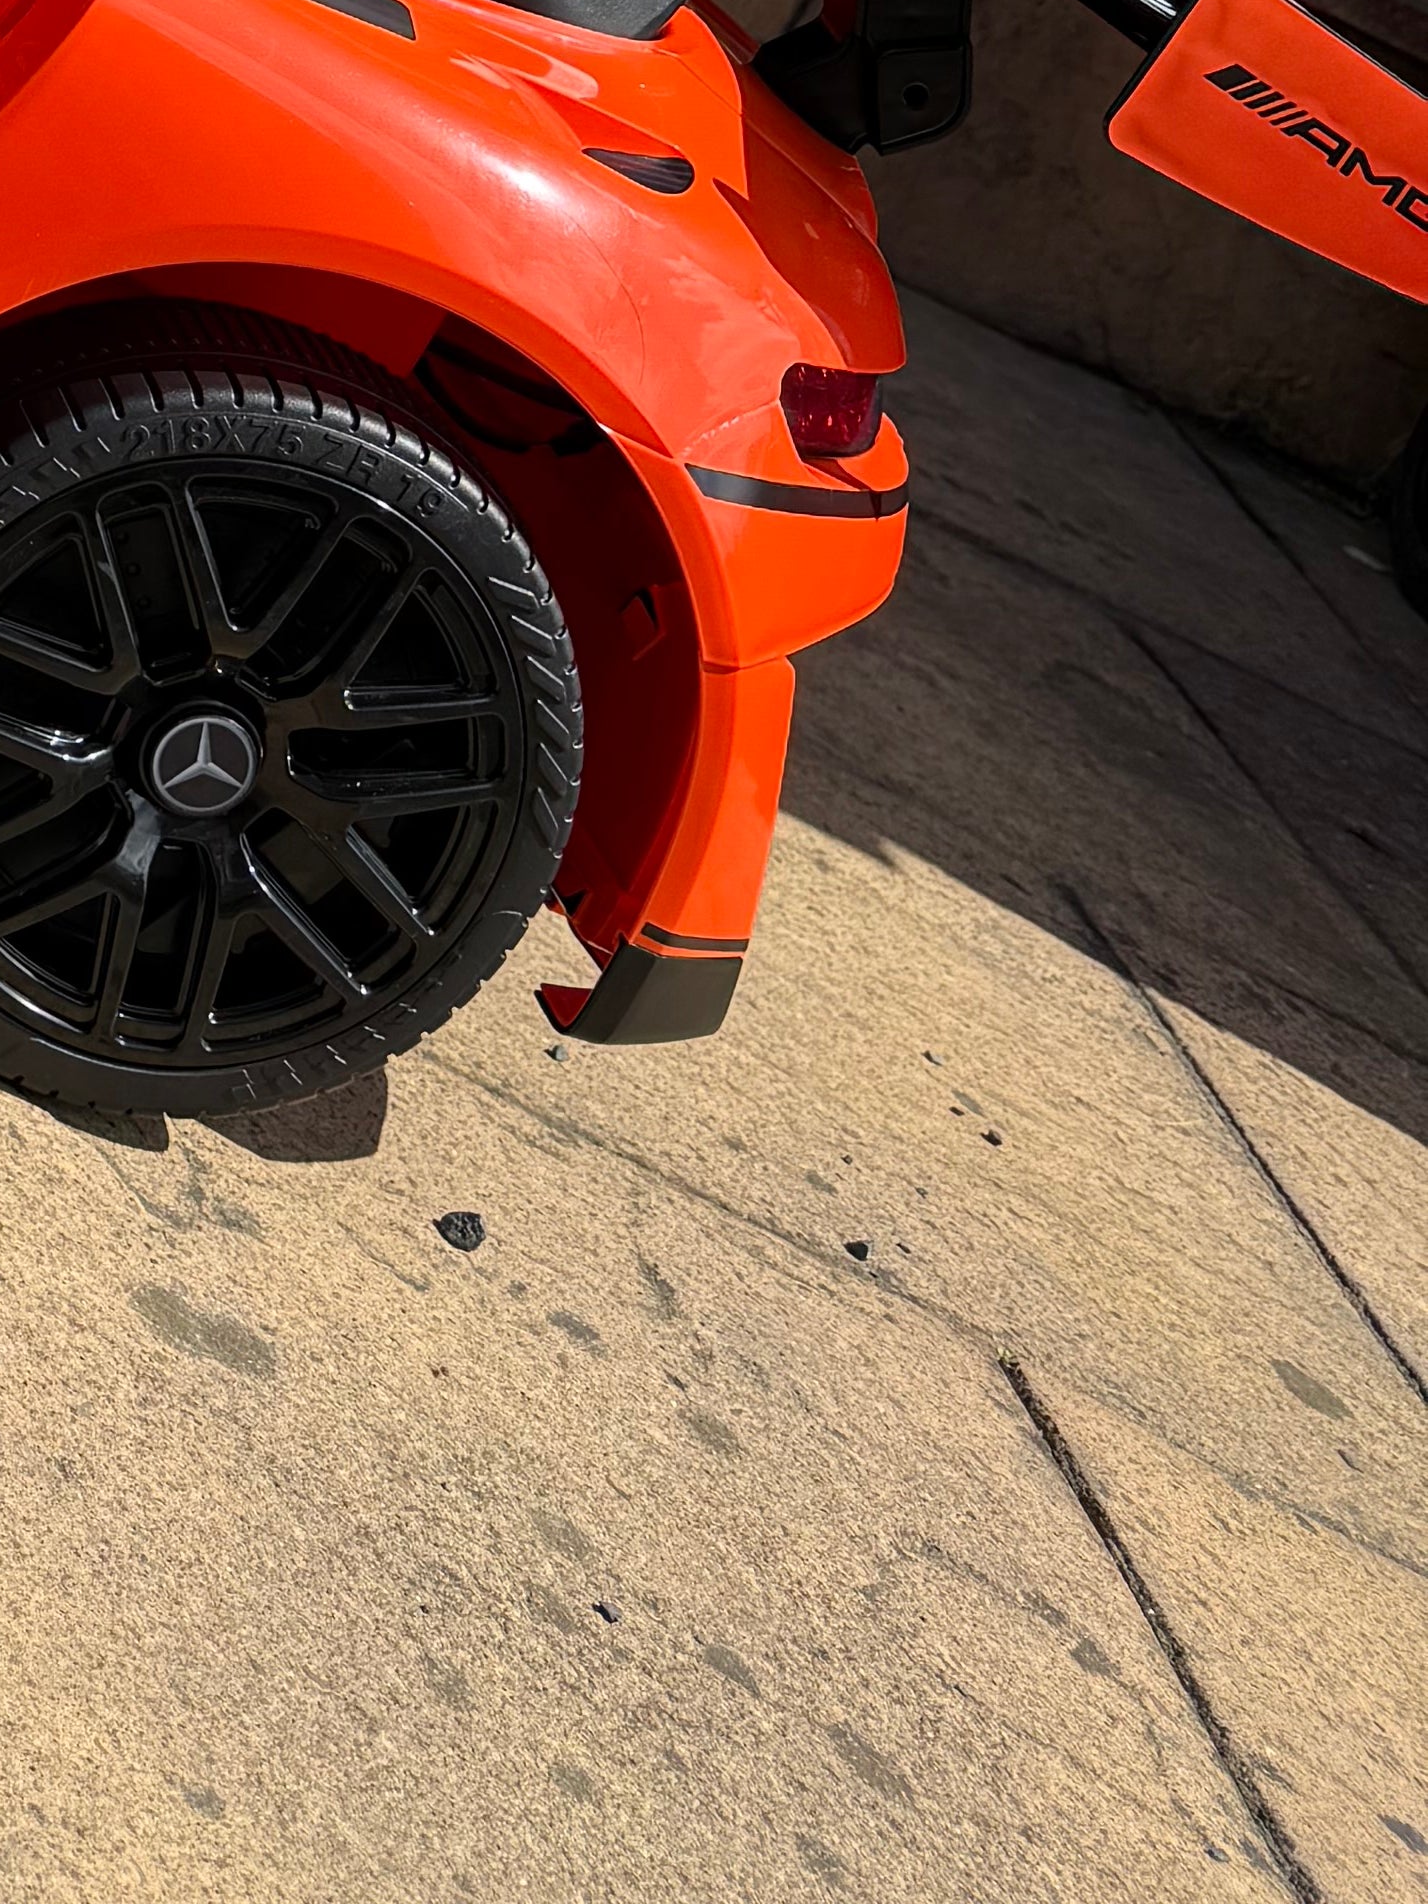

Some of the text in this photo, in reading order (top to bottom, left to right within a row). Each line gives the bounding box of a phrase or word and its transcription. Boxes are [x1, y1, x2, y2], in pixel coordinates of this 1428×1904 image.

[122, 414, 443, 519] 218X75 ZR 19
